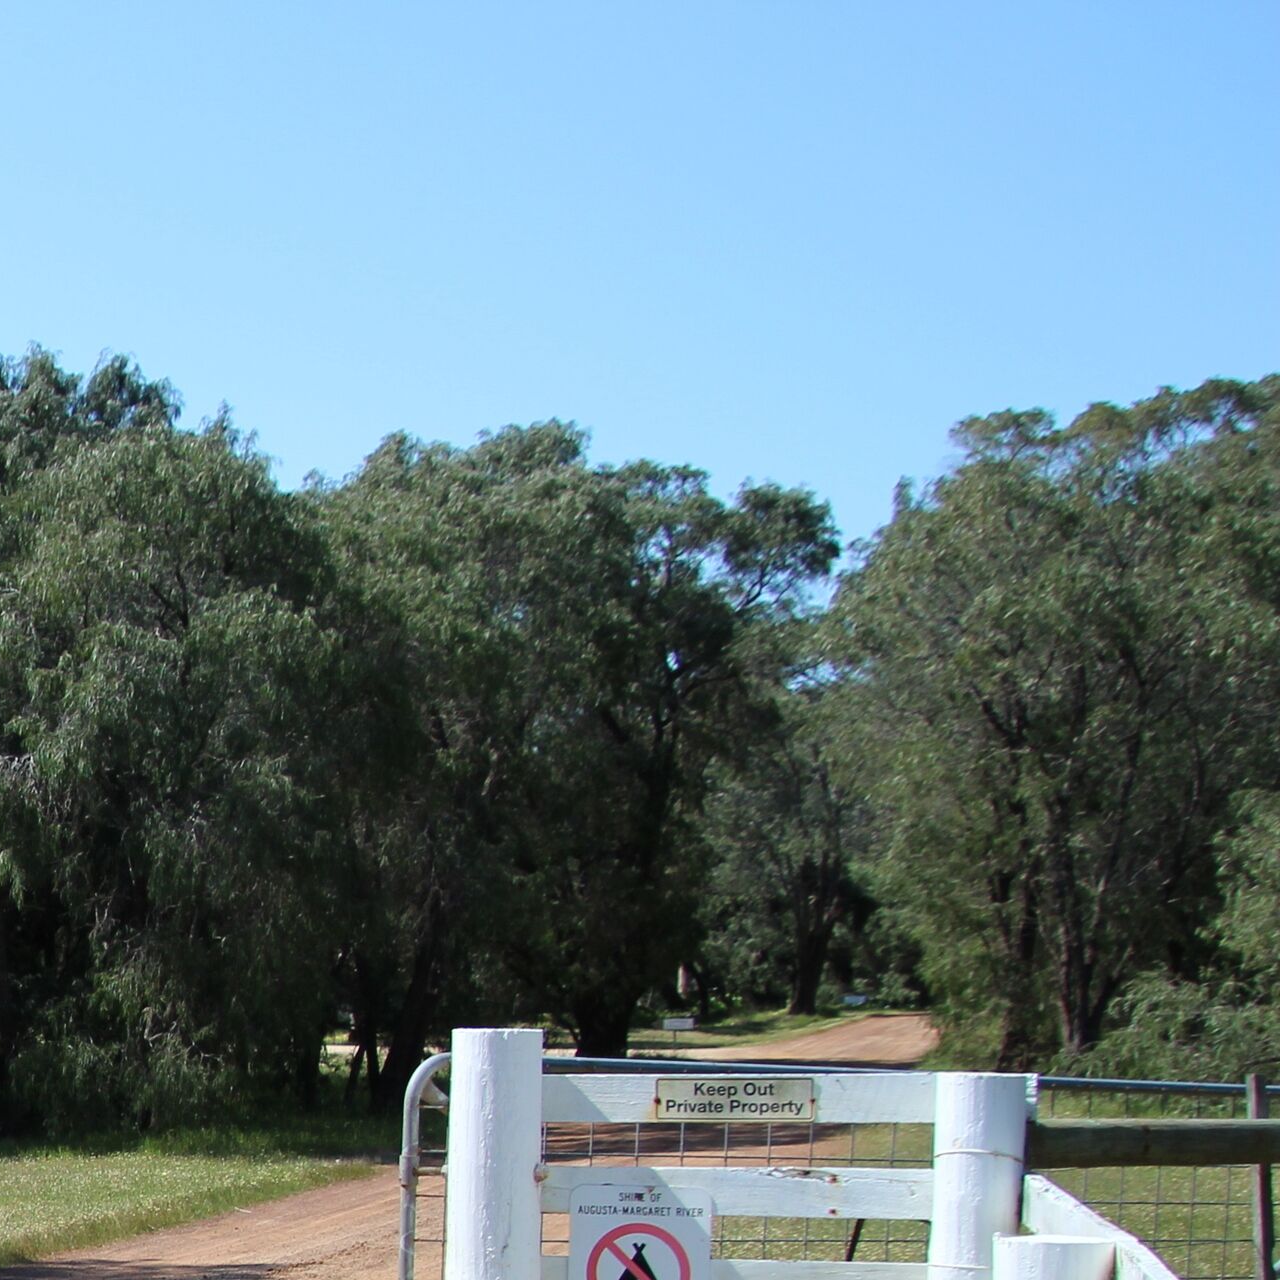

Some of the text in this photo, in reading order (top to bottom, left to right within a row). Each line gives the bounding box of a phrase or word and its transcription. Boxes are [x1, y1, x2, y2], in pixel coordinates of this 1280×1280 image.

[693, 1082, 775, 1098] Keep Out
[665, 1100, 804, 1115] Private Property
[650, 1193, 662, 1203] OF
[578, 1205, 704, 1217] AUGUSTA-MARGARET RIVER
